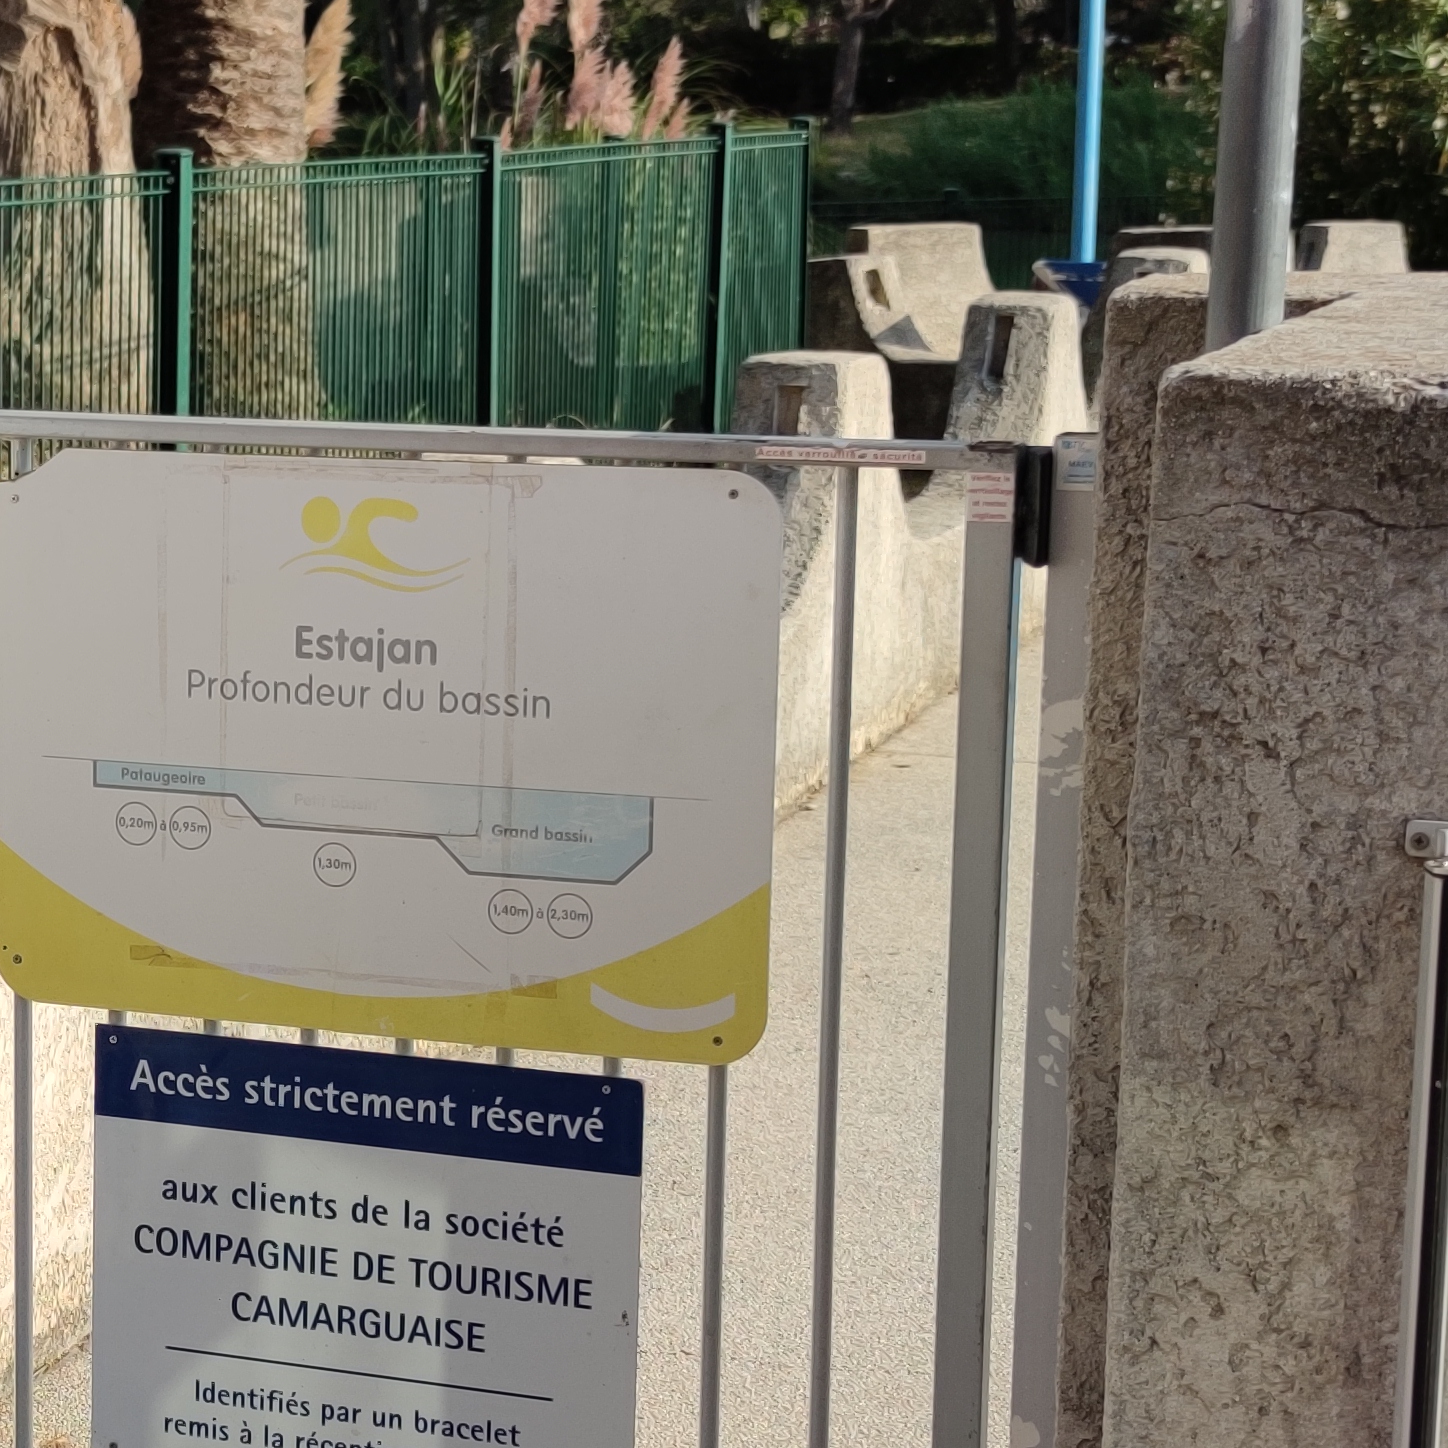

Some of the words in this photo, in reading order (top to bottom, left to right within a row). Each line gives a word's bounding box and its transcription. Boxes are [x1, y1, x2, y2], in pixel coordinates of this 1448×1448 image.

[293, 624, 438, 675] Estajan
[186, 668, 371, 713] Profondeur
[383, 674, 425, 713] du
[438, 679, 551, 721] bassin
[119, 817, 154, 829] 0,20m
[160, 820, 167, 831] à
[172, 820, 207, 834] 0,95m
[492, 824, 539, 840] Grand
[318, 857, 351, 871] 1,30m
[493, 904, 528, 918] 1,40m
[536, 908, 544, 919] à
[550, 909, 589, 922] 2,30m
[130, 1059, 231, 1102] Accès
[244, 1075, 456, 1127] strictement
[470, 1096, 605, 1143] réservé
[162, 1179, 219, 1206] aux
[231, 1180, 338, 1221] clients
[351, 1195, 388, 1227] de
[403, 1200, 430, 1232] la
[445, 1212, 565, 1249] société
[133, 1224, 339, 1278] COMPAGNIE
[352, 1251, 396, 1285] DE
[409, 1257, 594, 1311] TOURISME
[231, 1292, 487, 1353] CAMARGUAISE
[164, 1415, 229, 1442] remis
[240, 1419, 253, 1445] à
[195, 1379, 311, 1418] Identifiés
[321, 1402, 362, 1428] par
[372, 1407, 402, 1431] un
[415, 1410, 522, 1448] bracelet
